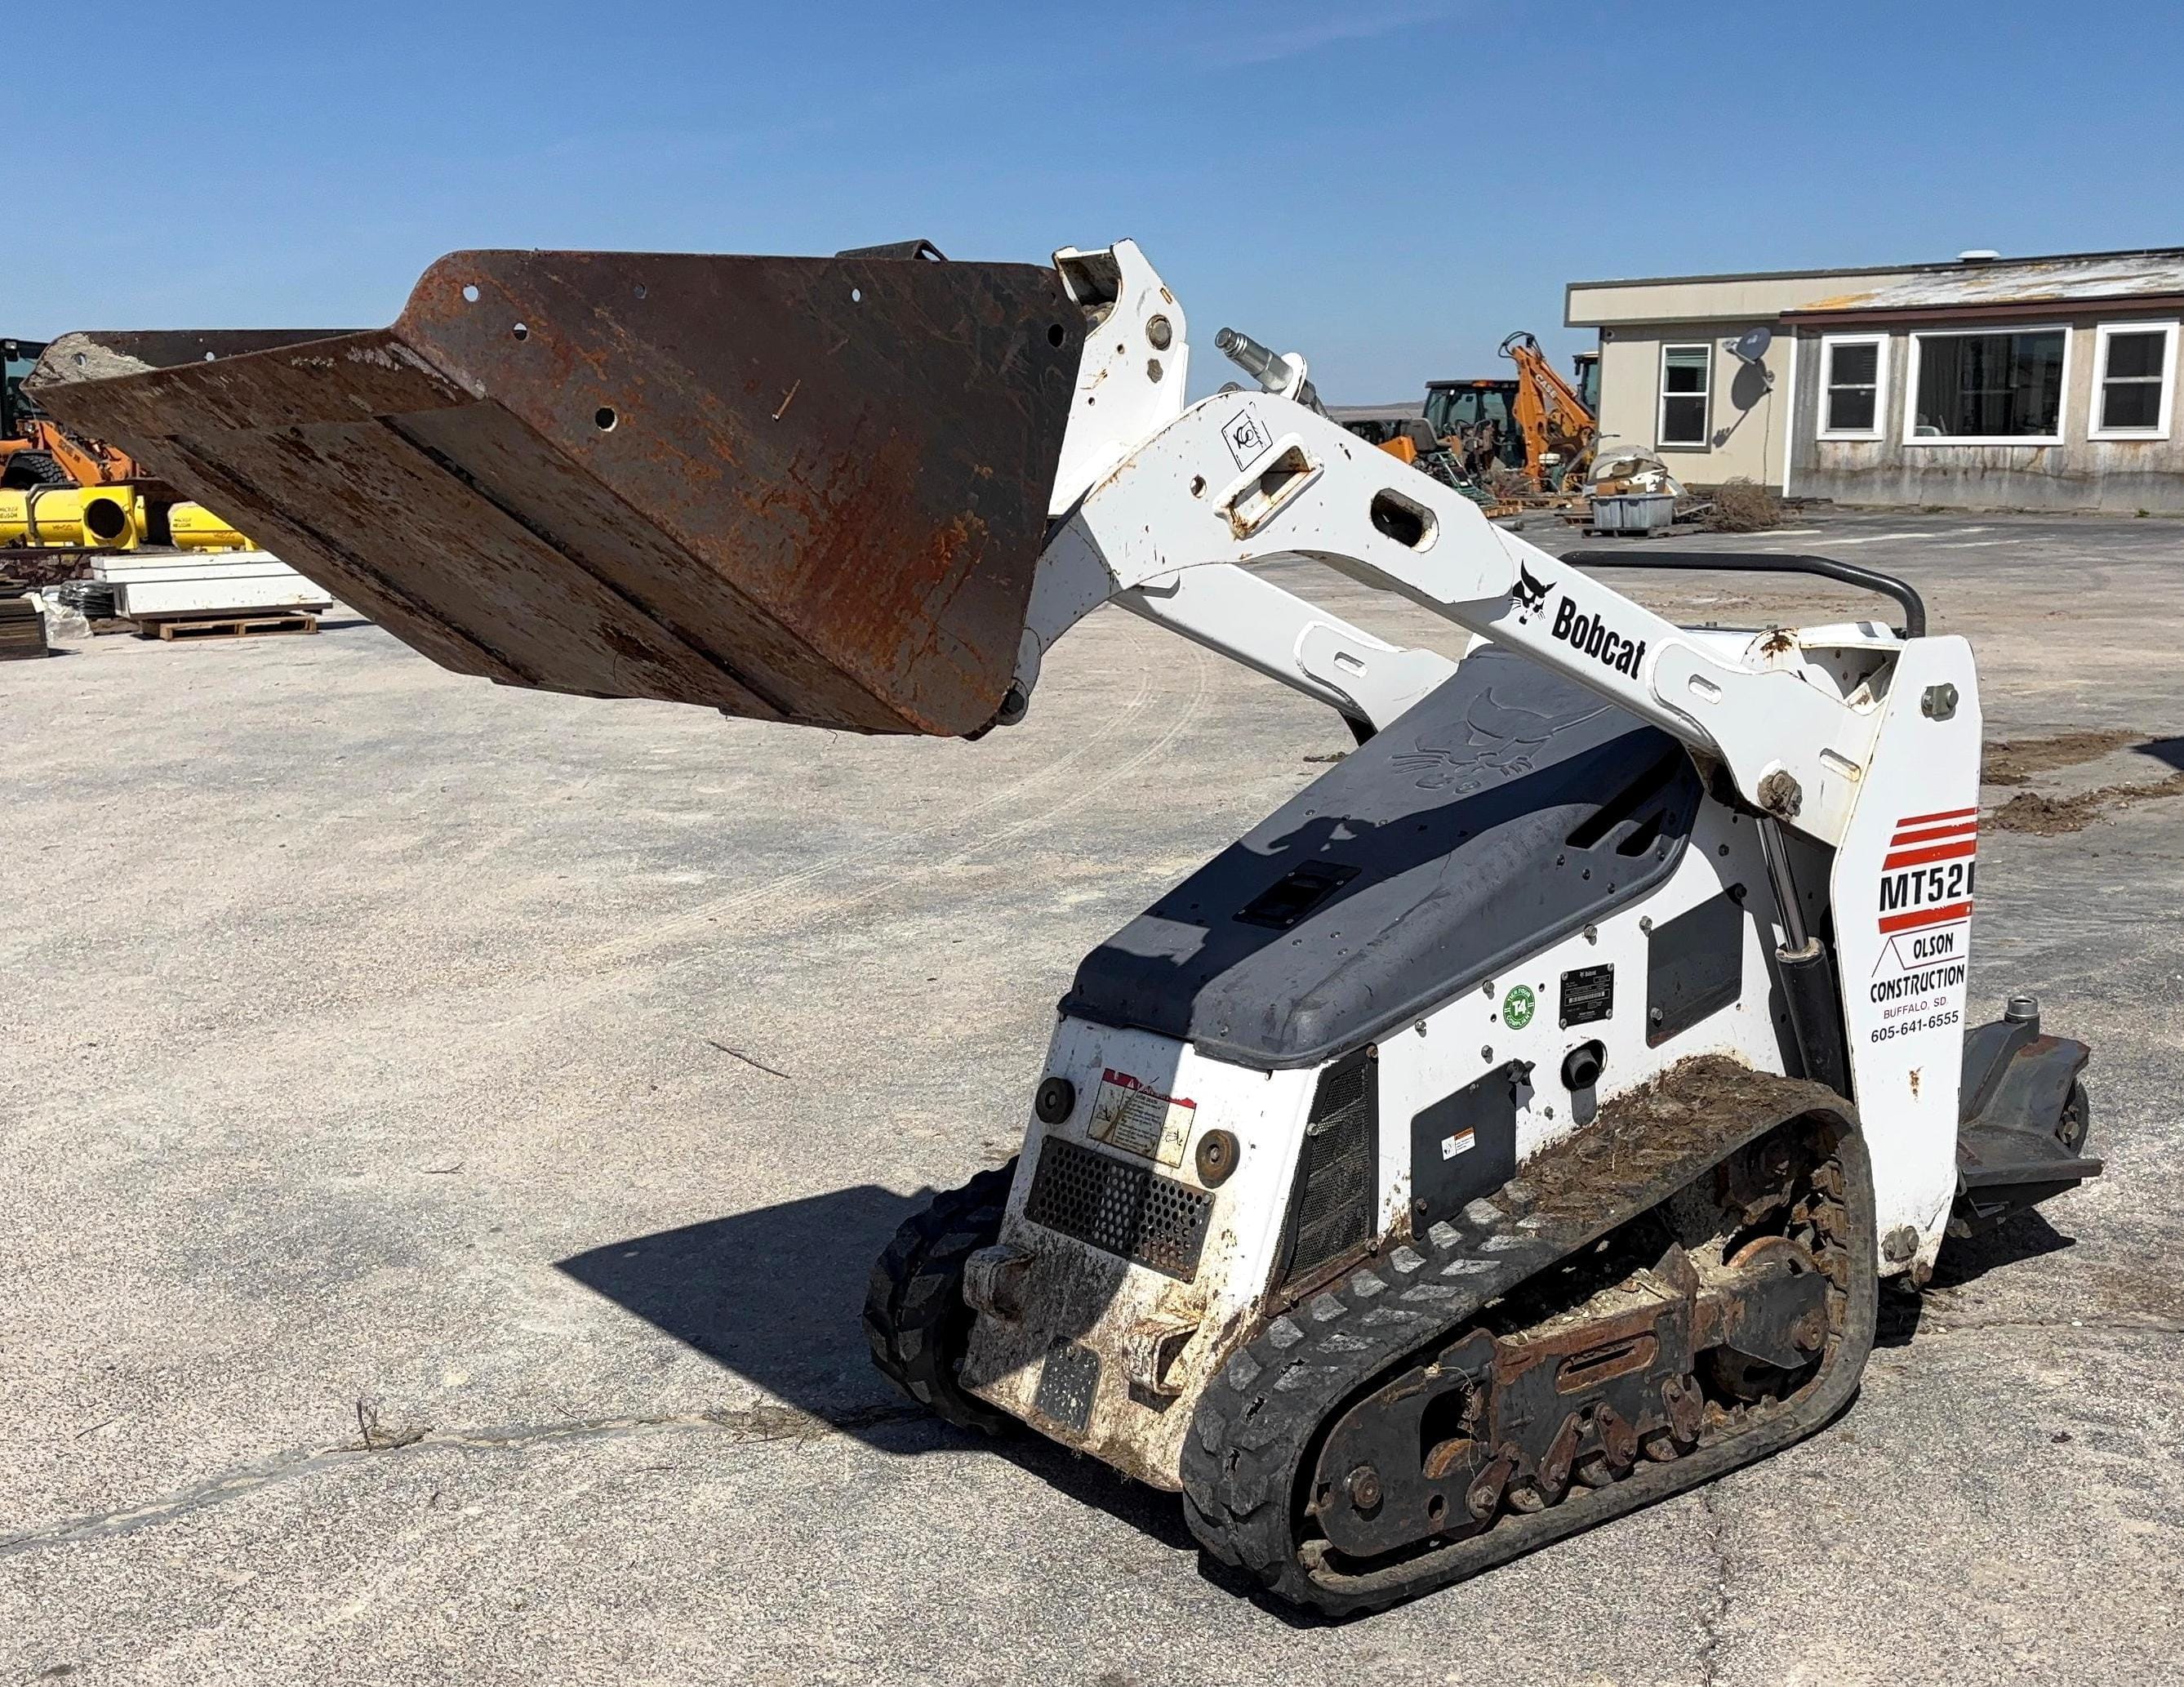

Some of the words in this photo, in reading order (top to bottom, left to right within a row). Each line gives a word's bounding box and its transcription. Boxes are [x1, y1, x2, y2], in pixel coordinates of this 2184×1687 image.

[1536, 374, 1556, 398] CASE
[1551, 595, 1646, 680] Bobcat
[1913, 933, 1954, 959] OLSON
[1870, 964, 1964, 1004] CONSTRUCTION
[1506, 1011, 1532, 1026] COMPLIANT
[1512, 999, 1526, 1017] T4
[1884, 1000, 1930, 1019] BUFFALO,
[1871, 1010, 1959, 1043] 605-641-6555
